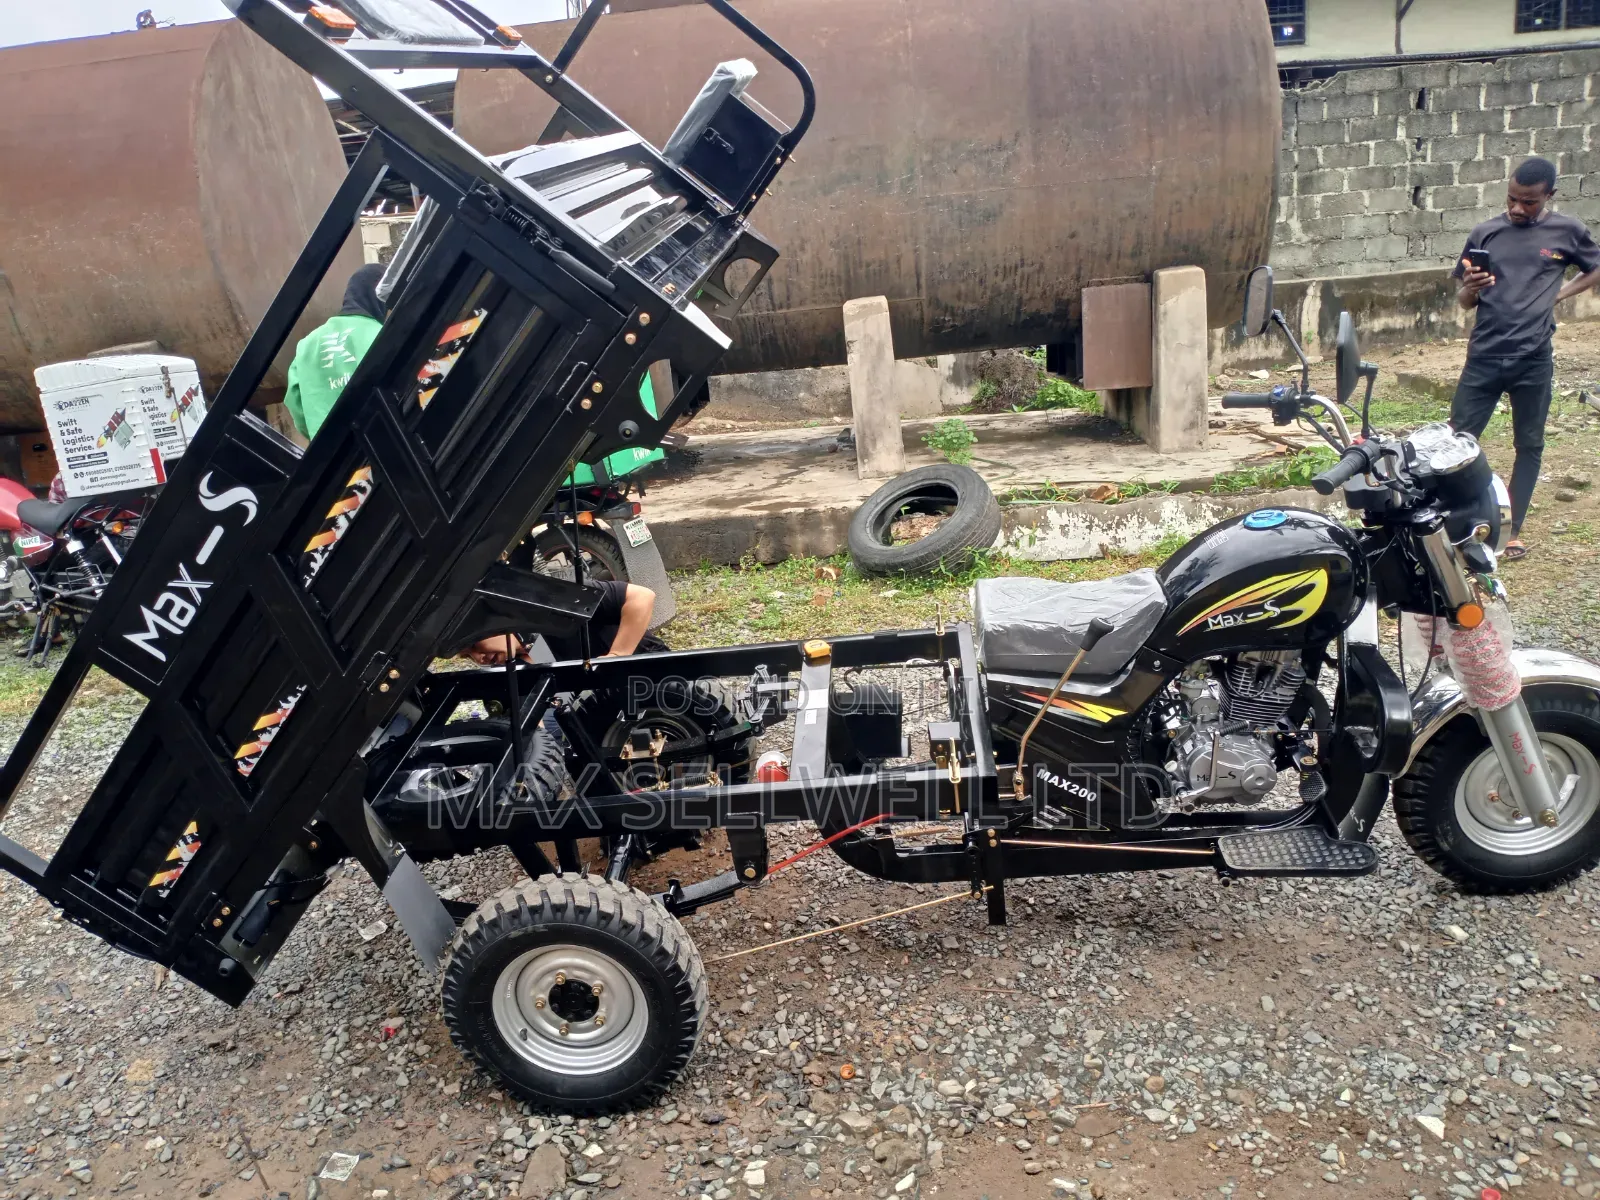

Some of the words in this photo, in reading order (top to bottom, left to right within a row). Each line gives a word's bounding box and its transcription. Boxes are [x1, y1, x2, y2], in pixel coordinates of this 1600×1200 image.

[141, 398, 156, 406] Swift
[57, 418, 78, 428] Swift
[67, 427, 83, 437] Safe
[62, 435, 95, 447] Logistics
[64, 444, 95, 455] Service.
[20, 536, 40, 546] NIKE
[1036, 767, 1098, 803] MAX200
